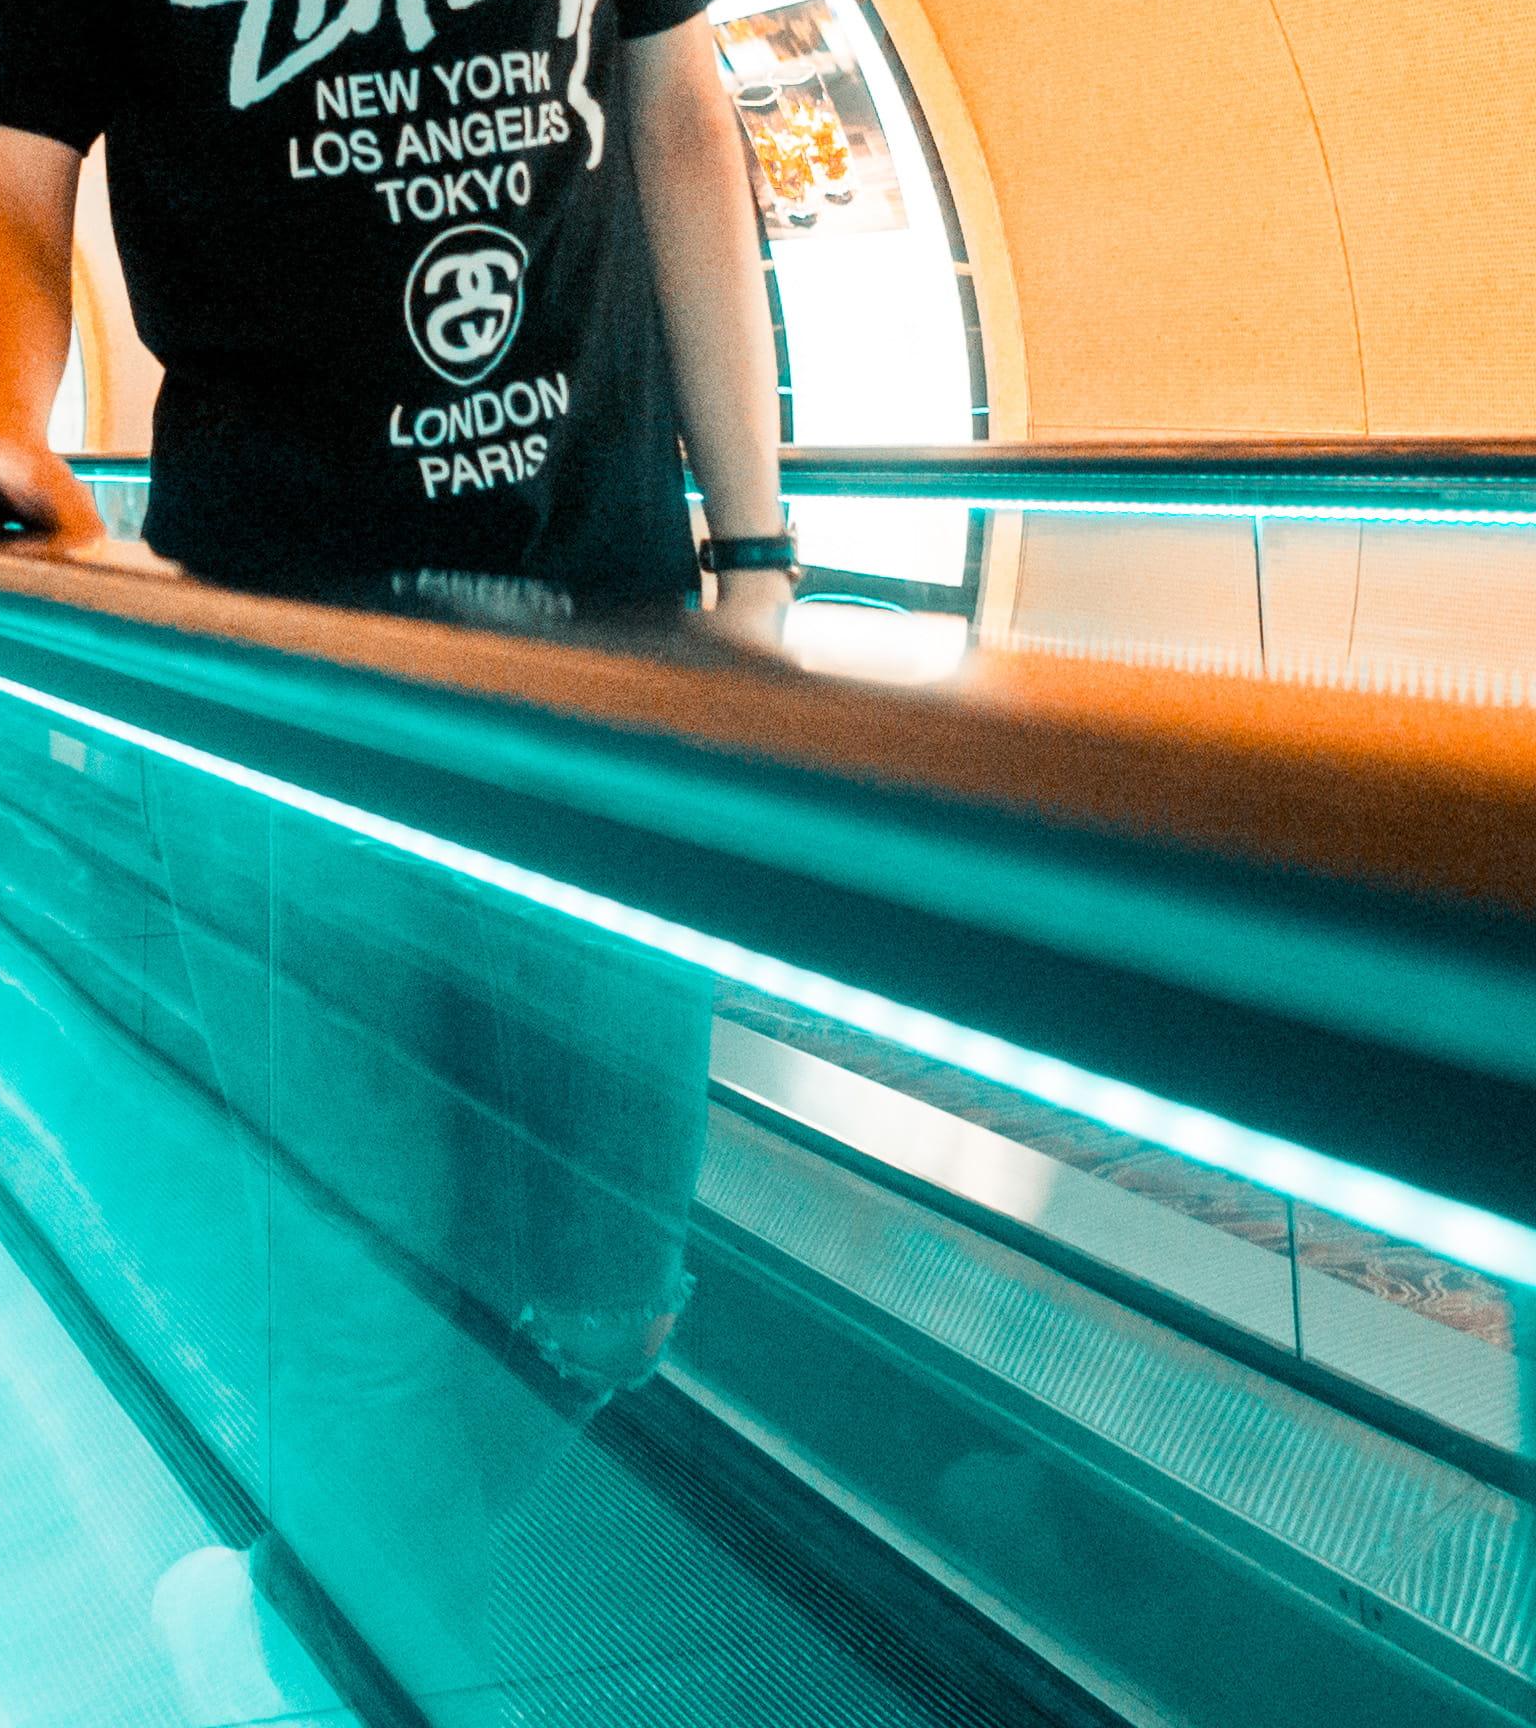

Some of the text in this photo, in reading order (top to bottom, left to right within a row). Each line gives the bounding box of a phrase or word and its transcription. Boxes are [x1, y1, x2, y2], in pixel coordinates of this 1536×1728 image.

[316, 51, 551, 121] NEW YORK
[289, 100, 571, 179] LOS ANGELES
[375, 160, 532, 224] TOKYO
[390, 372, 570, 447] LONDON
[418, 433, 549, 499] PARIS
